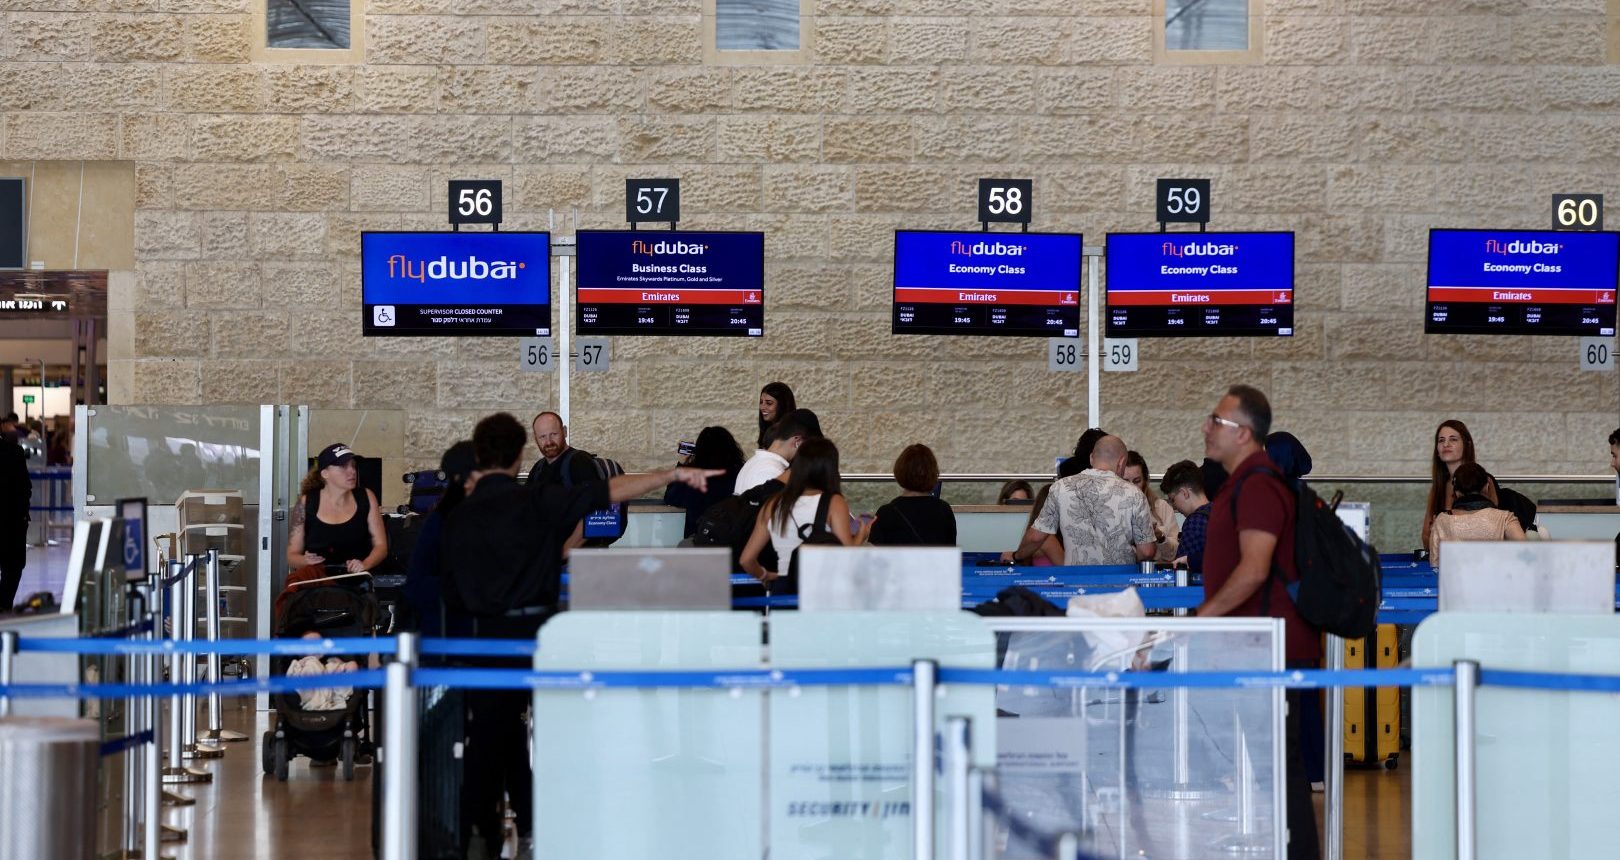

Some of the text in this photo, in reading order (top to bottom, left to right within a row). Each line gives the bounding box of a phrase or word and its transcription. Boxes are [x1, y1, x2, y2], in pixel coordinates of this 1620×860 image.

[459, 189, 492, 215] 56
[637, 188, 668, 213] 57
[989, 188, 1022, 214] 58
[1167, 188, 1200, 213] 59
[1558, 199, 1597, 225] 60
[632, 241, 708, 256] flydubai
[952, 241, 1026, 256] flydubai
[1162, 242, 1238, 257] flydubai
[1487, 240, 1563, 255] flydubai
[387, 255, 525, 283] flydubai
[633, 264, 706, 273] Business Class
[950, 264, 1025, 275] Economy Class
[1161, 265, 1237, 276] Economy Class
[1484, 263, 1561, 274] Economy Class
[642, 293, 679, 301] Emirates
[960, 292, 997, 301] Emirates
[1171, 293, 1209, 302] Emirates
[1494, 292, 1531, 301] Emirates
[0, 301, 43, 309] המראו
[528, 345, 547, 365] 56
[584, 346, 602, 365] 57
[1057, 345, 1075, 364] 58
[1112, 345, 1130, 364] 59
[1588, 344, 1607, 364] 60
[788, 802, 869, 815] SECURITY
